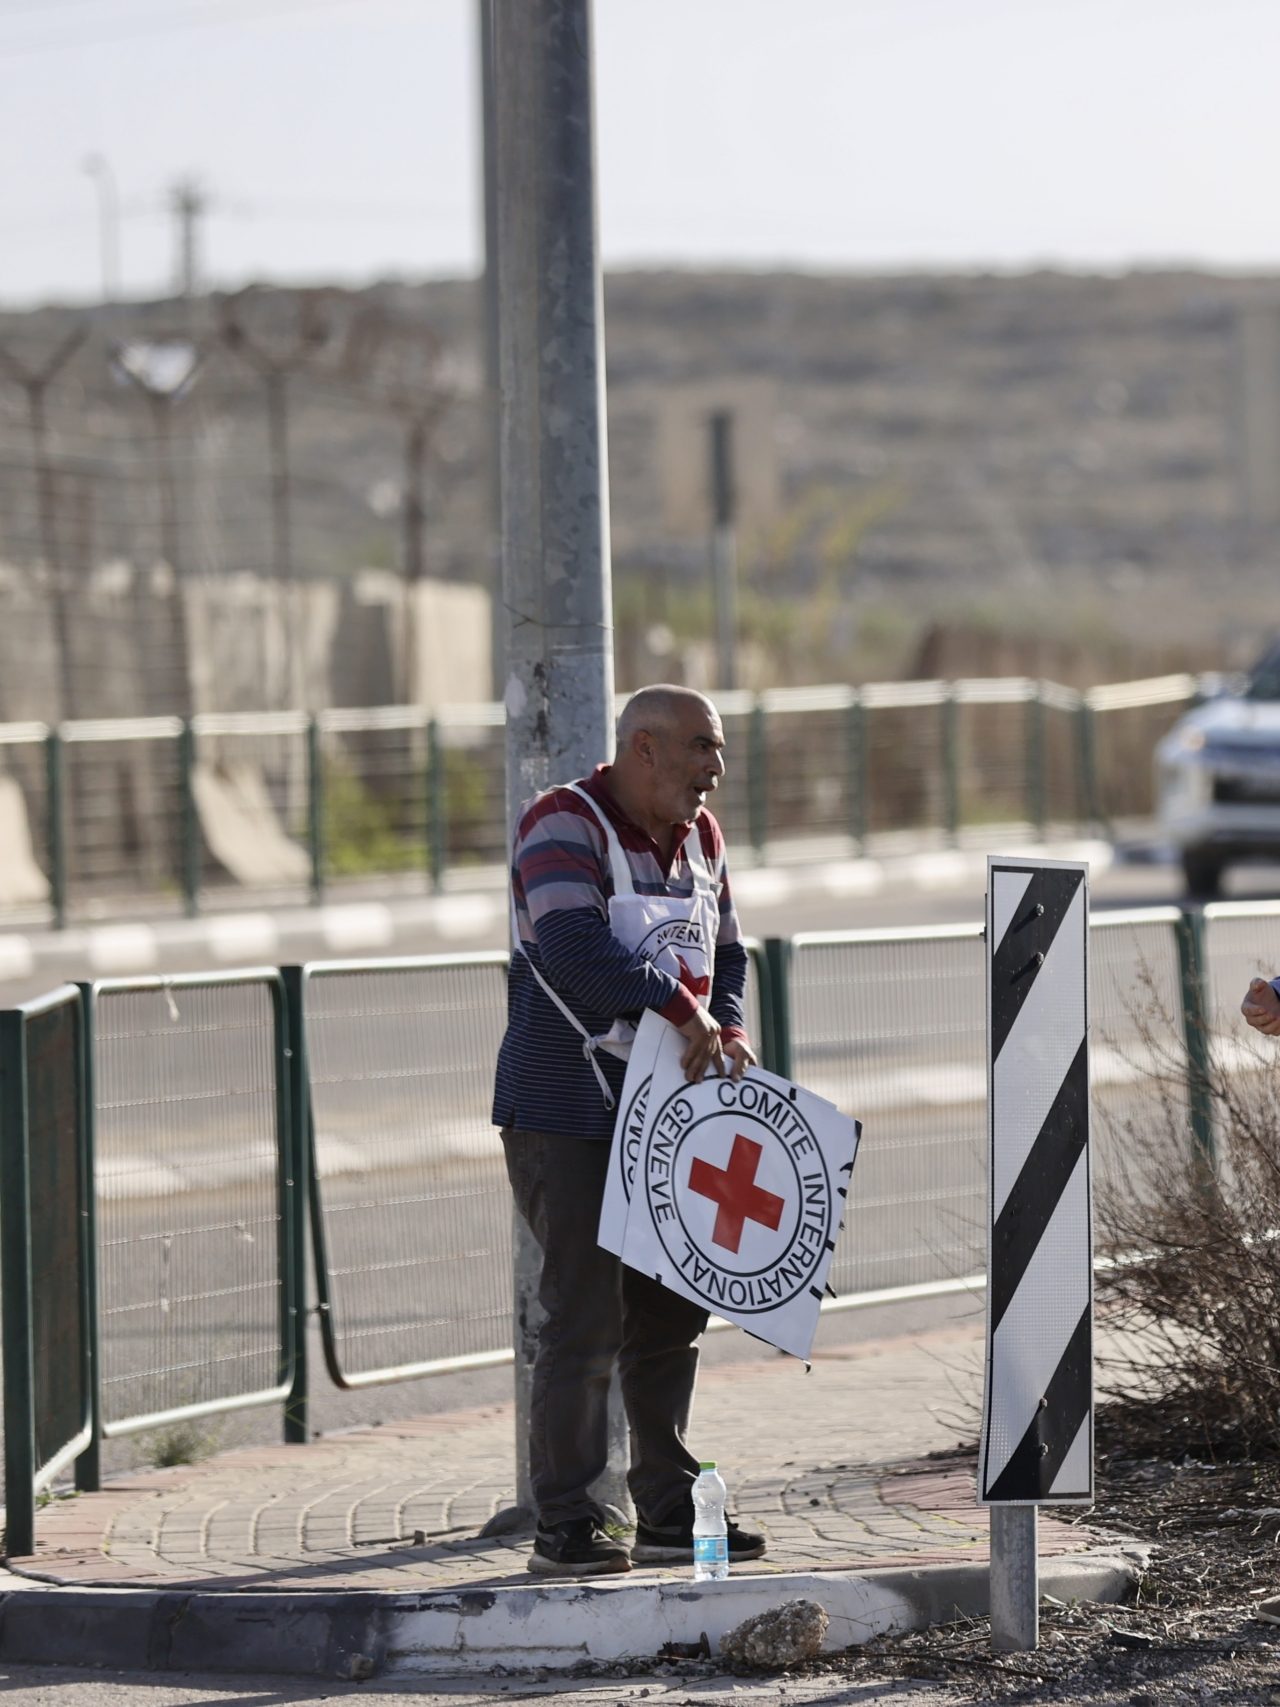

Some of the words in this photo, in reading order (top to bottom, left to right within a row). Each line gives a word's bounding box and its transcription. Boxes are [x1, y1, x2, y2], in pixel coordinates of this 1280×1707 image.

[651, 1099, 694, 1224] GENEVE
[718, 1082, 815, 1160] COMITE
[680, 1173, 826, 1306] INTERNATIONAL
